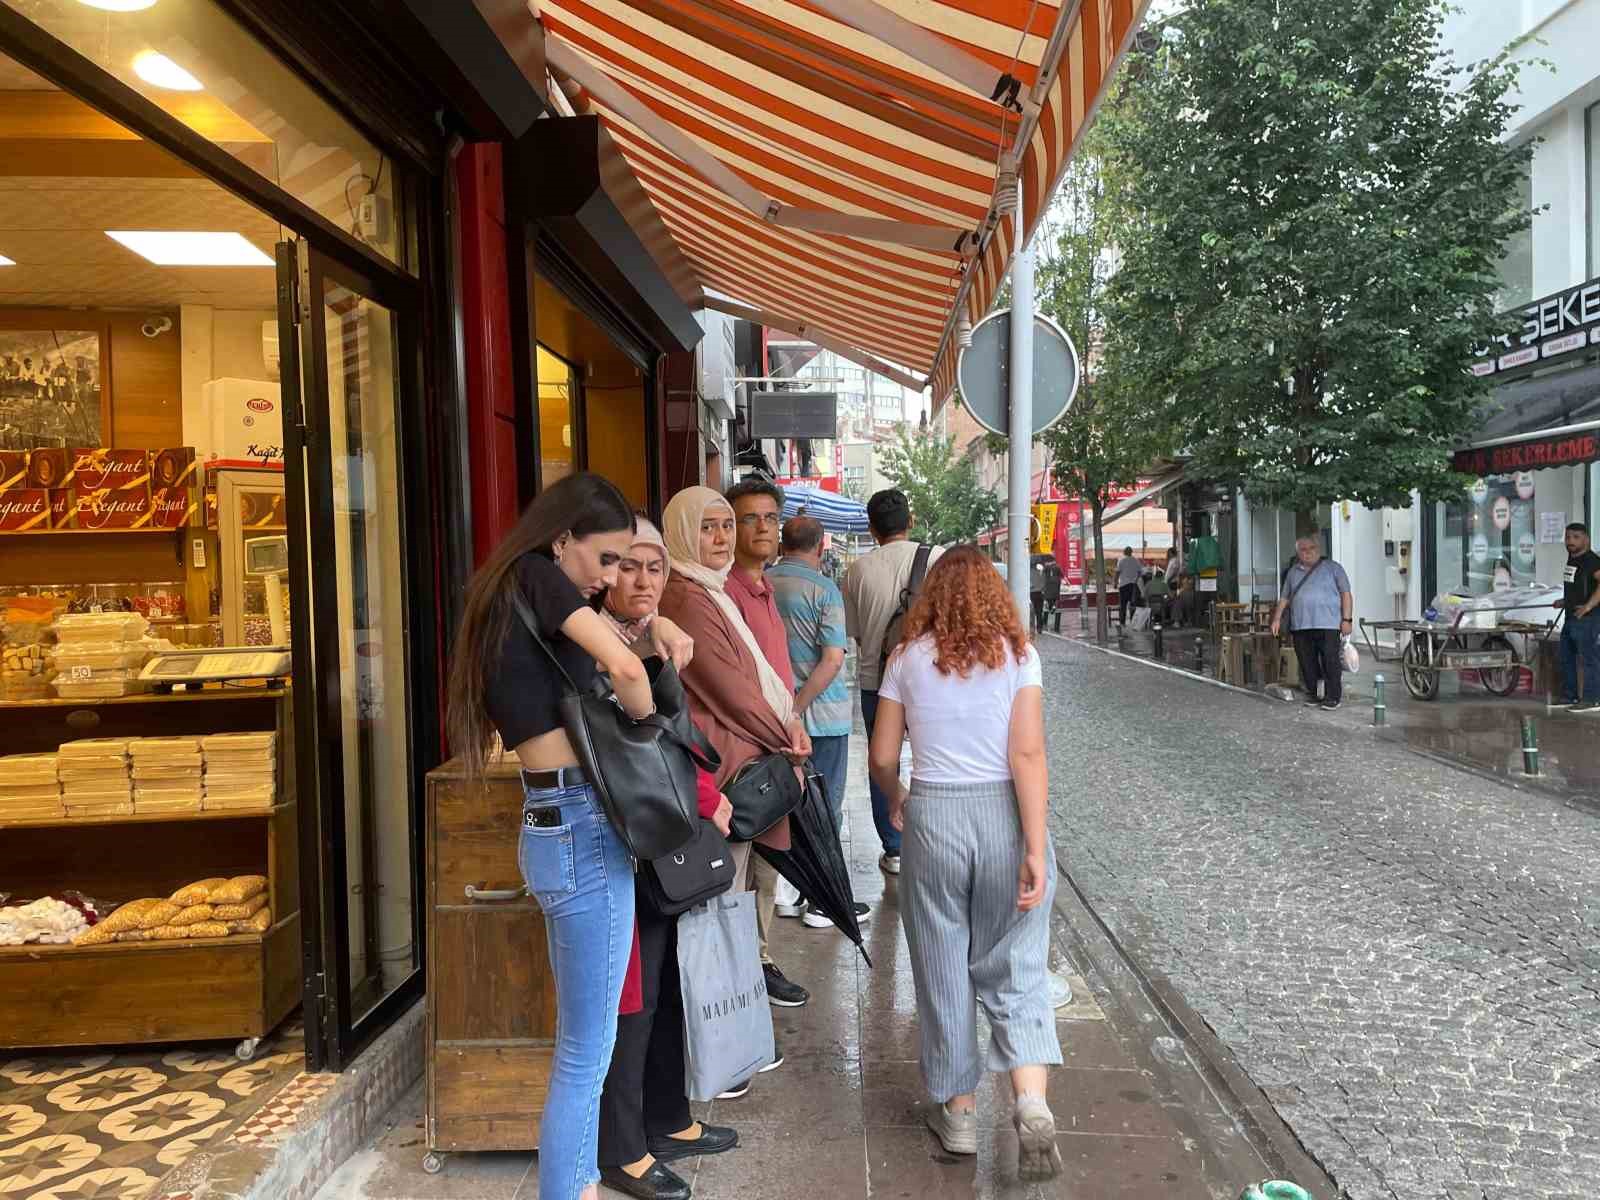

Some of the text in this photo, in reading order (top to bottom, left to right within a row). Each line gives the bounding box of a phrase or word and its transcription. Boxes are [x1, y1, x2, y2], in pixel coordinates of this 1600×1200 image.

[74, 454, 144, 489] Egant
[78, 495, 145, 529] Eegant
[73, 666, 90, 678] 50
